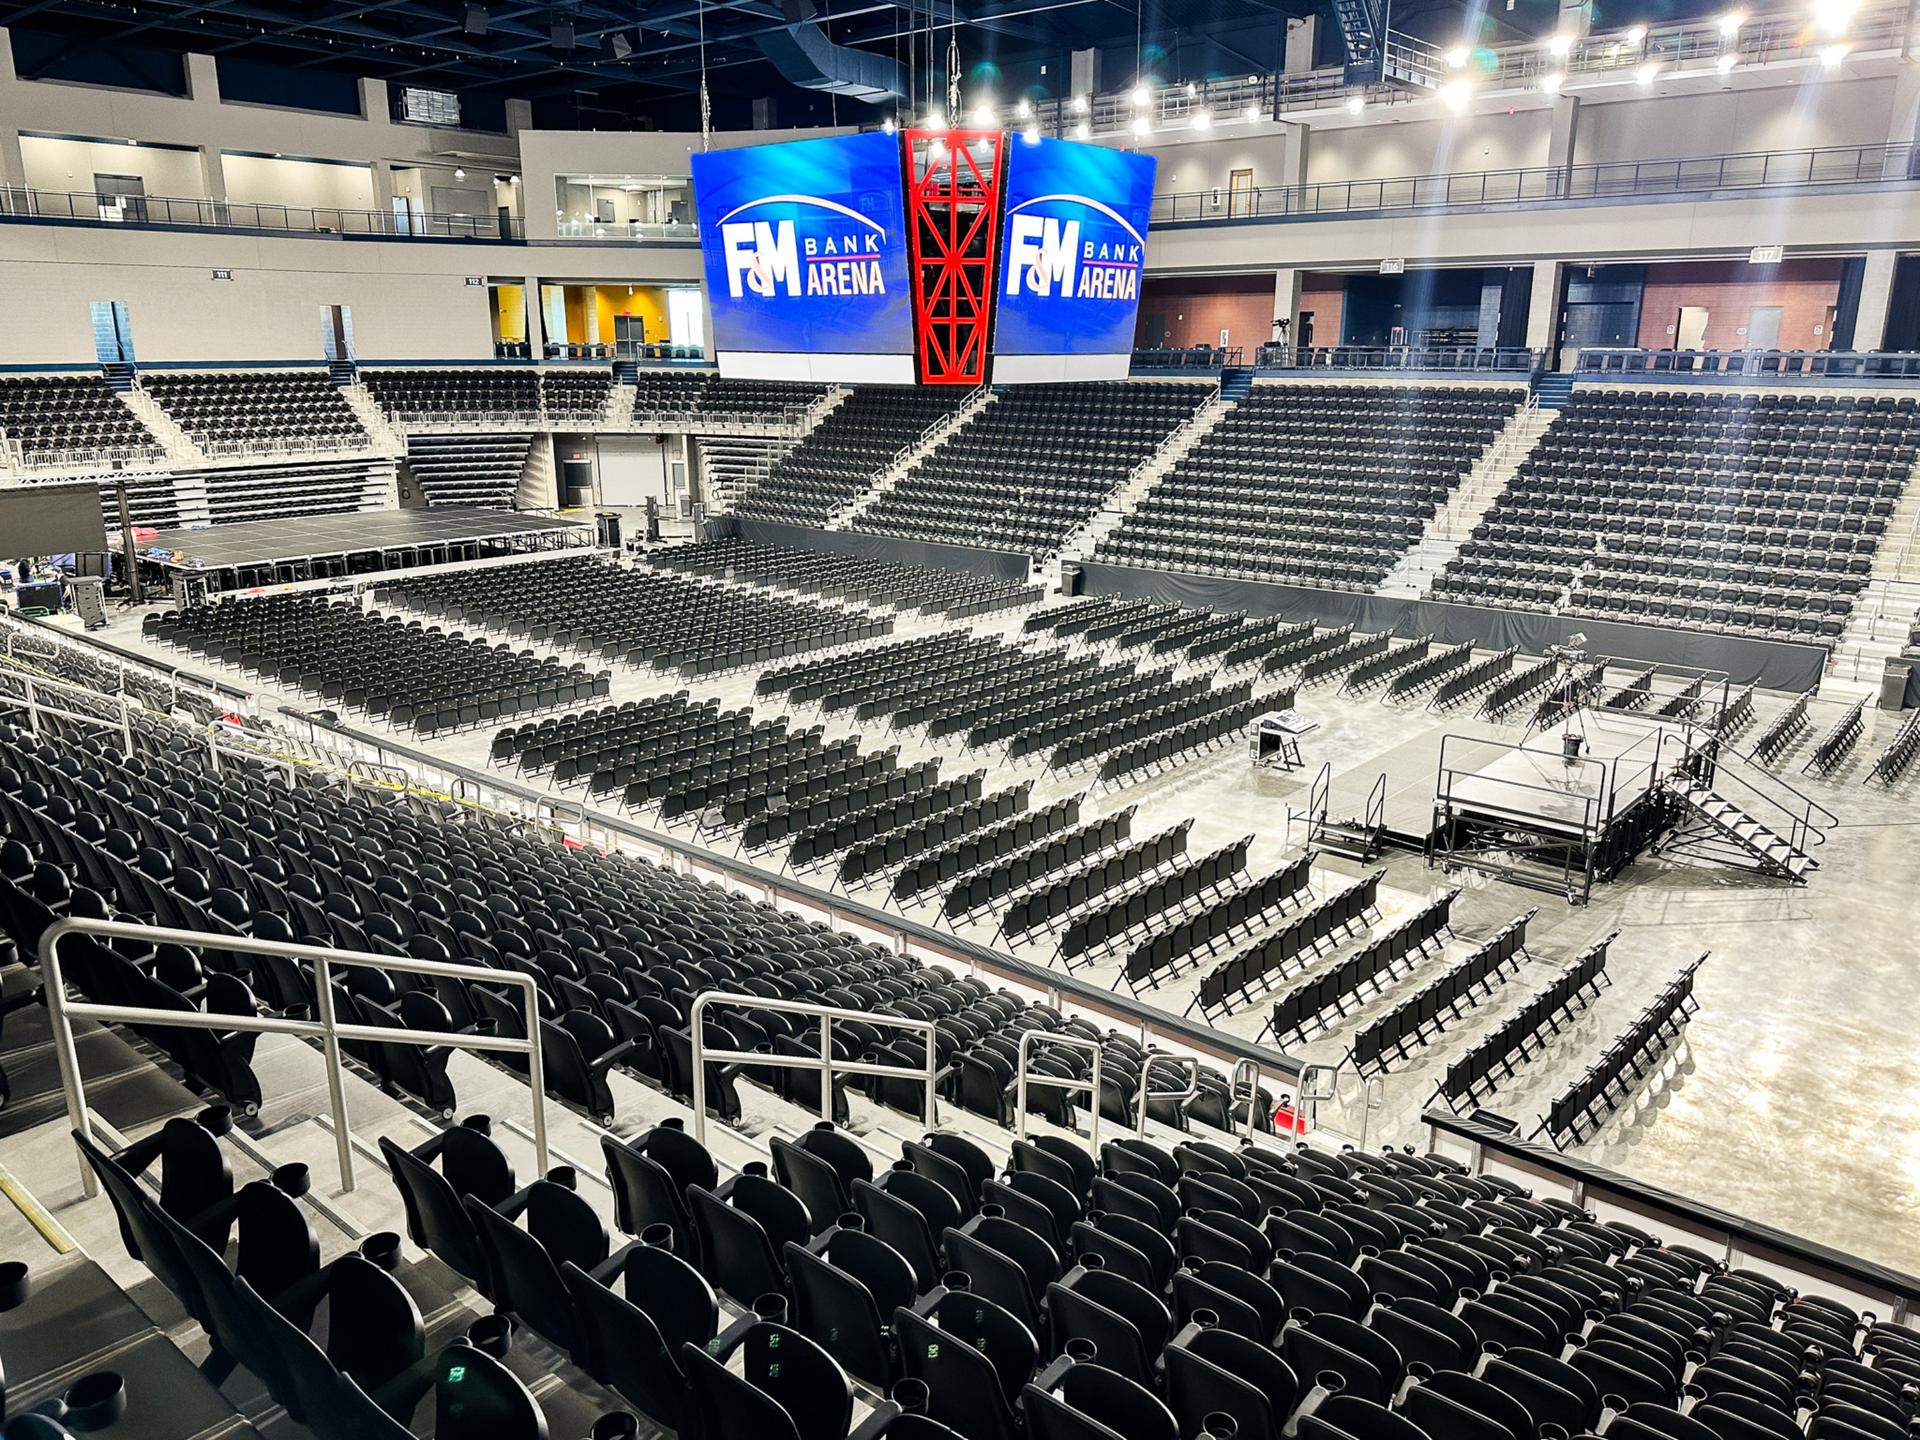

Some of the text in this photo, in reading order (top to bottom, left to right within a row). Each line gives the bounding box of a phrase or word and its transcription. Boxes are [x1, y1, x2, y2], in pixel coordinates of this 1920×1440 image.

[804, 234, 880, 255] BANK
[1006, 214, 1080, 297] F&M
[1083, 241, 1140, 261] BANK
[1758, 250, 1776, 260] 117
[722, 220, 801, 297] F&M
[1385, 262, 1399, 271] 116
[807, 261, 886, 296] ARENA
[1077, 266, 1137, 300] ARENA
